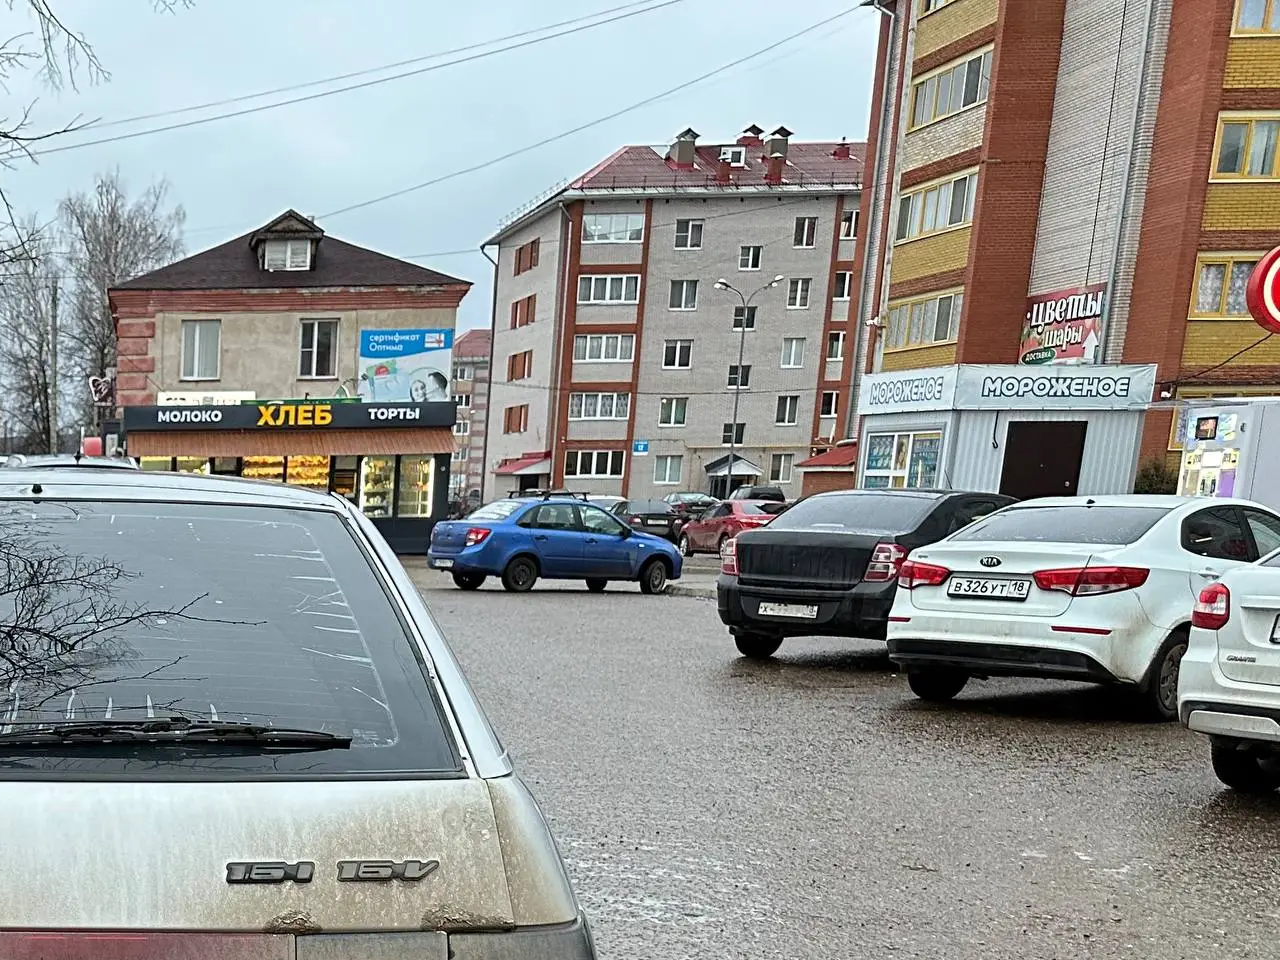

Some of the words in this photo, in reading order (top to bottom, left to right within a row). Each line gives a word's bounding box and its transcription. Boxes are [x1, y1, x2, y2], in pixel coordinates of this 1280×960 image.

[369, 332, 420, 343] сертификат
[369, 343, 403, 351] Оптима
[869, 376, 944, 404] МОРОЖЕНОЕ
[982, 376, 1130, 397] МОРОЖЕНОЕ
[157, 409, 223, 423] МОЛОКО
[257, 405, 333, 426] ХЛЕБ
[368, 408, 420, 420] ТОРТЫ
[982, 557, 998, 565] KIA
[1011, 581, 1025, 592] 18
